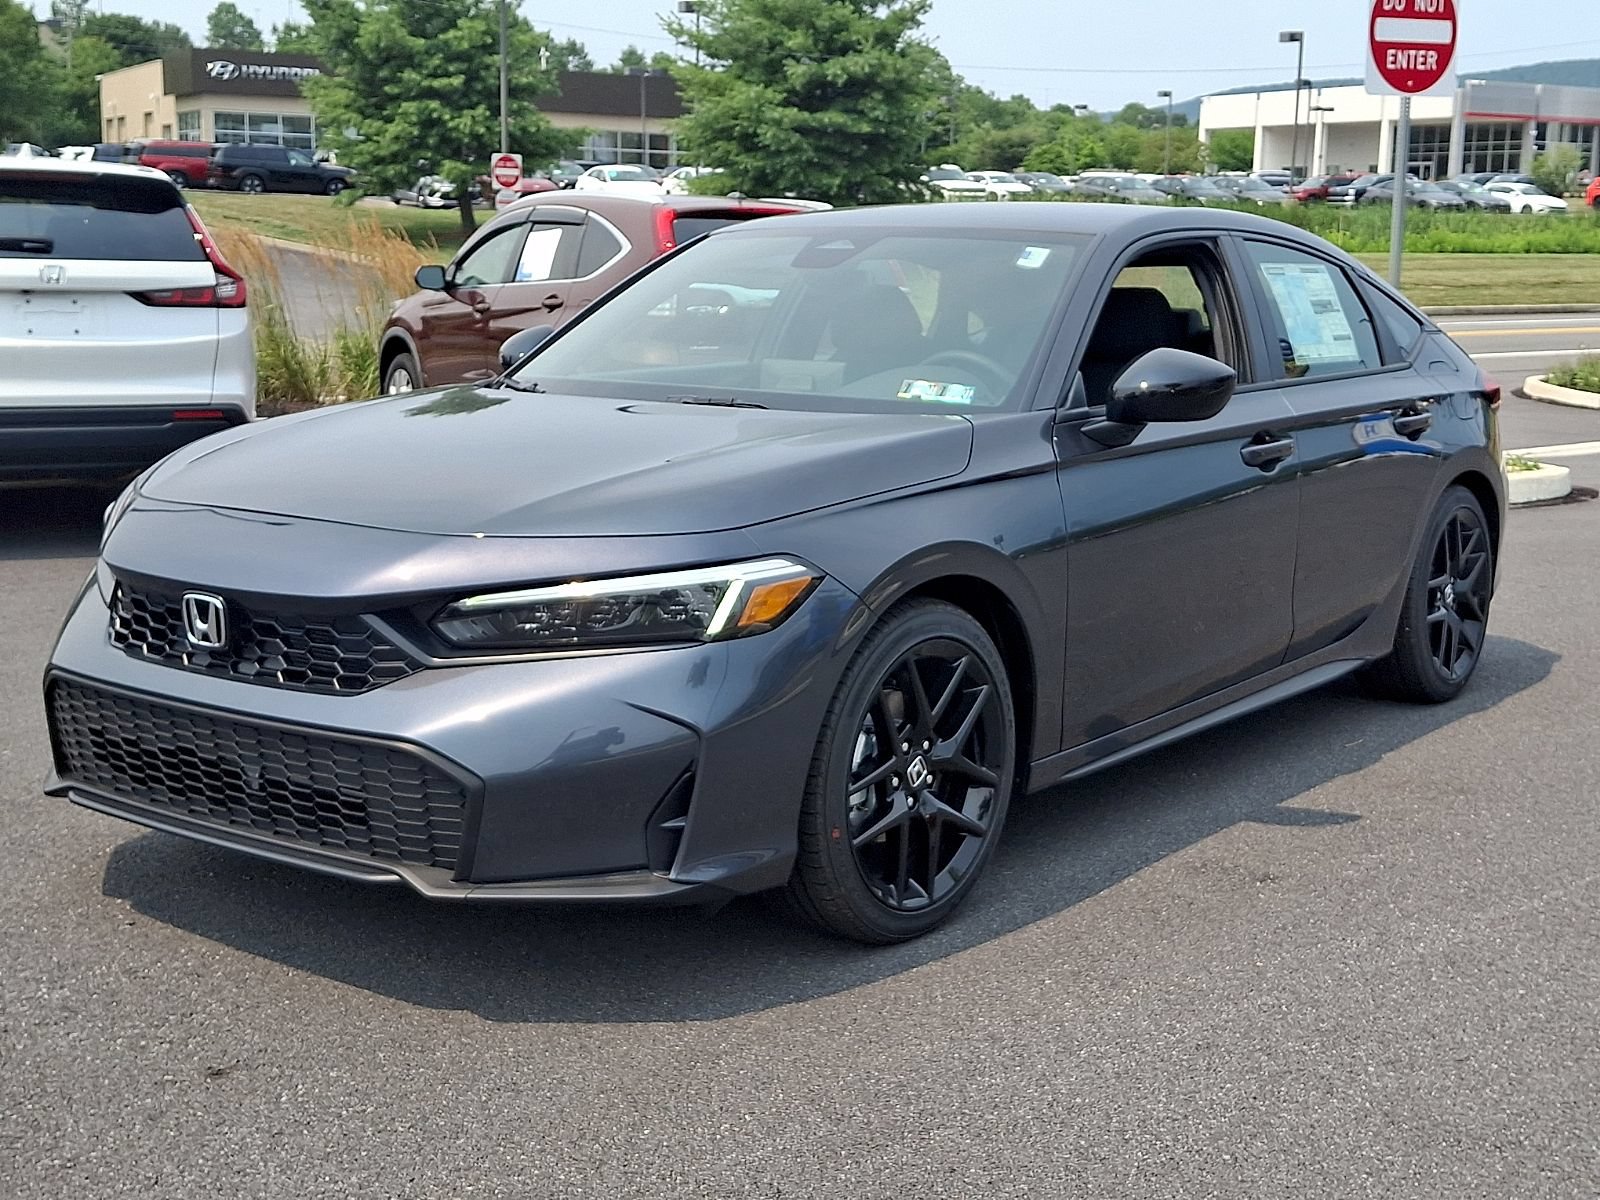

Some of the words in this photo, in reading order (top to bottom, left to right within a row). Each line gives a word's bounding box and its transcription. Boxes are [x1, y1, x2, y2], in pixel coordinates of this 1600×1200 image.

[1382, 0, 1406, 11] DO
[1414, 0, 1445, 13] NOT
[1386, 49, 1438, 70] ENTER
